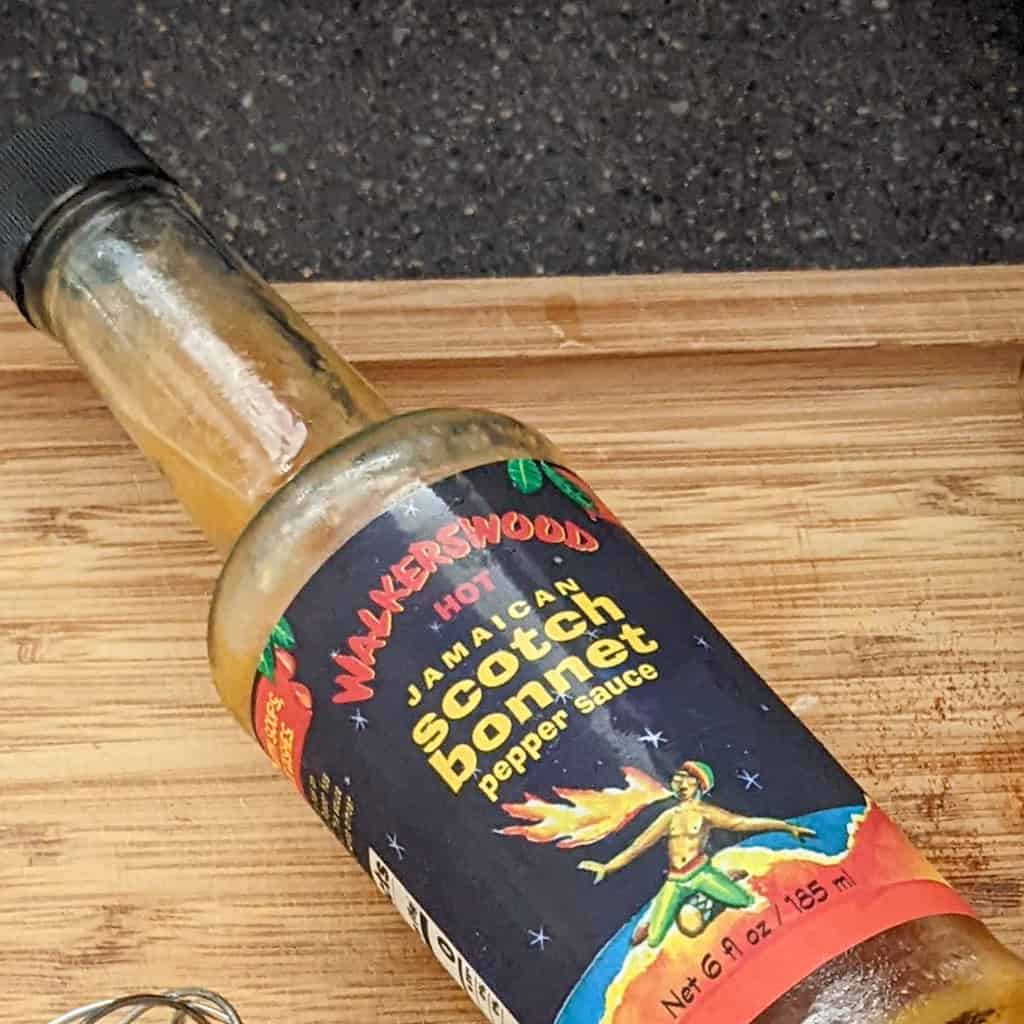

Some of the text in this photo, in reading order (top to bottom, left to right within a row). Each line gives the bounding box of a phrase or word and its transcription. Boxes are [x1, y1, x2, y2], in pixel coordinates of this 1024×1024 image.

[331, 511, 600, 705] WALKERSWOOD
[407, 577, 580, 707] JAMAICAN
[433, 570, 496, 621] HOT
[411, 591, 626, 754] scotch
[428, 623, 659, 794] bonnet
[478, 663, 659, 803] pepper sauce
[661, 976, 702, 1019] Net
[701, 953, 722, 980] 6
[746, 920, 772, 945] oz
[784, 880, 829, 913] 185
[832, 868, 857, 893] ml
